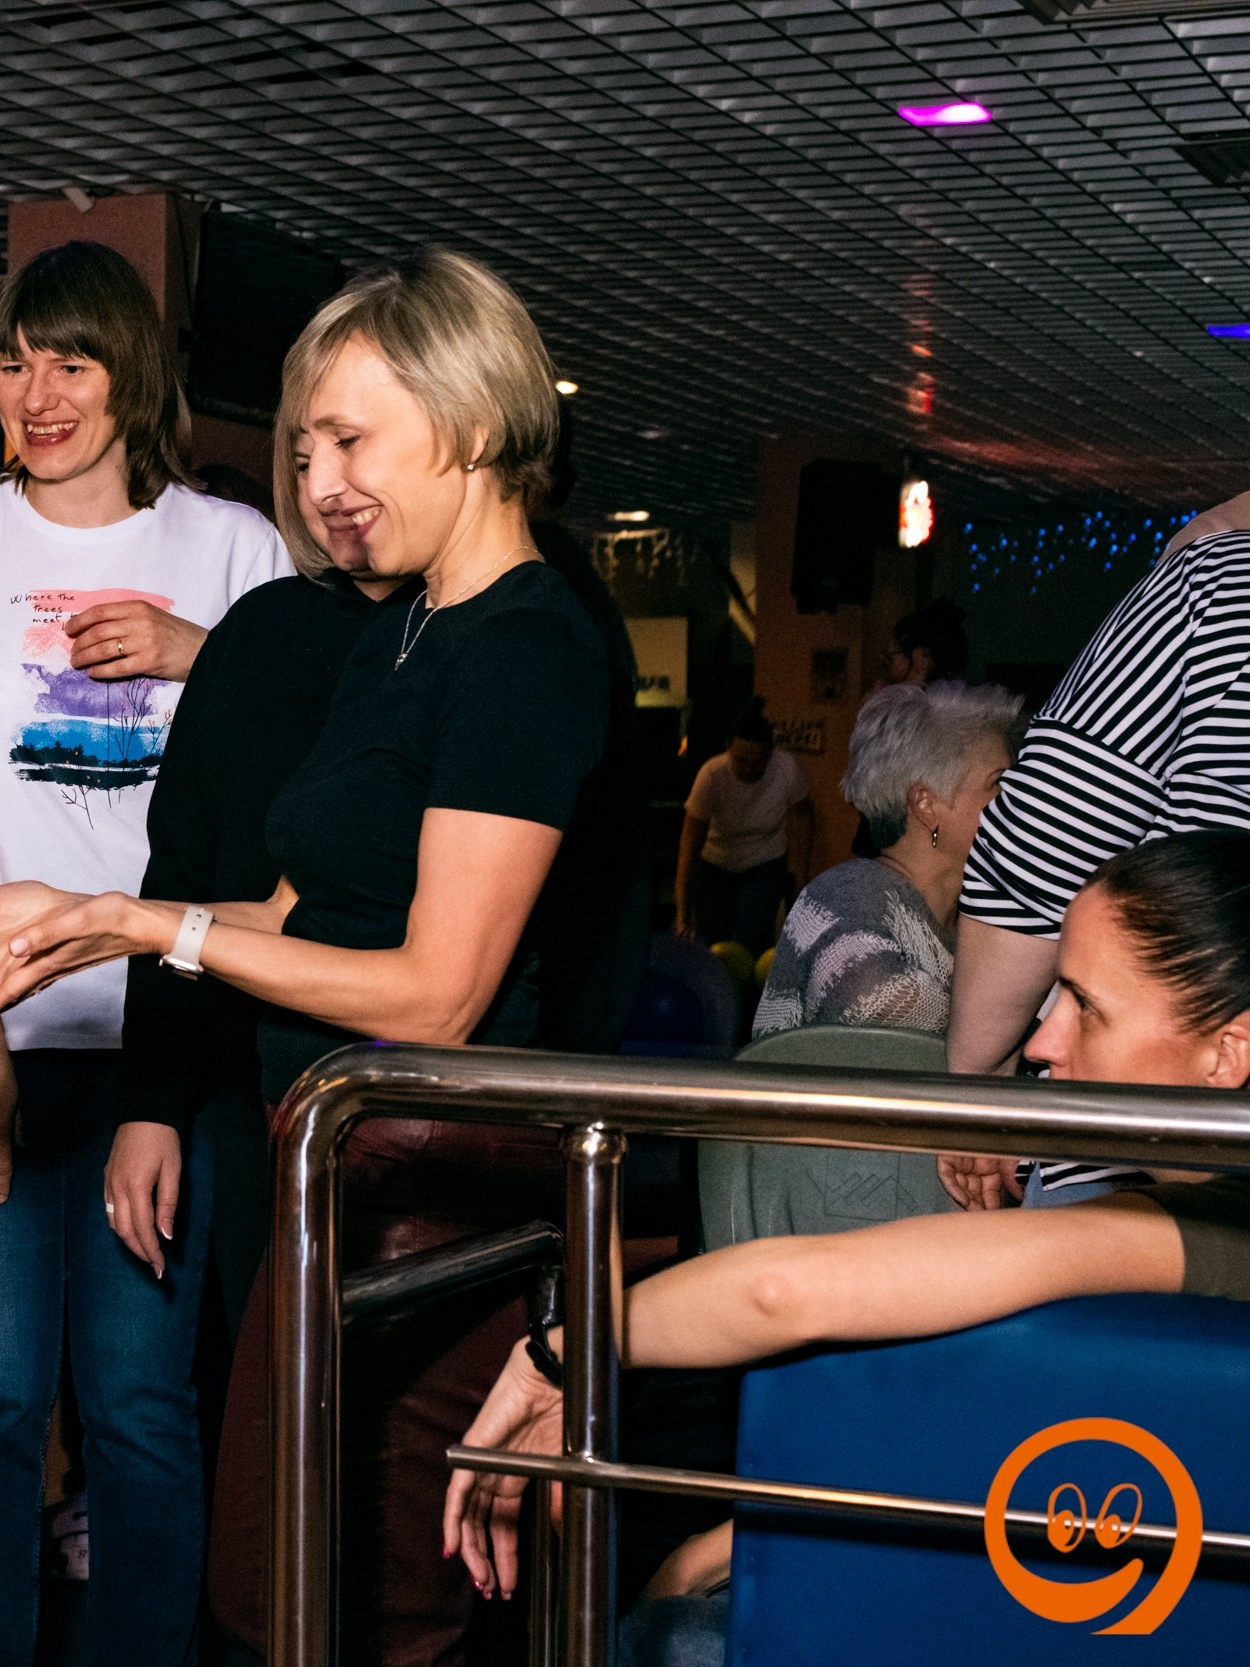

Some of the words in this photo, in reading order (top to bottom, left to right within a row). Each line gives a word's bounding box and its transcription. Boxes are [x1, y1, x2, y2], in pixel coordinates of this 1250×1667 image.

[10, 592, 52, 604] Where
[57, 592, 76, 601] the
[33, 604, 63, 613] trees
[32, 612, 62, 623] meet
